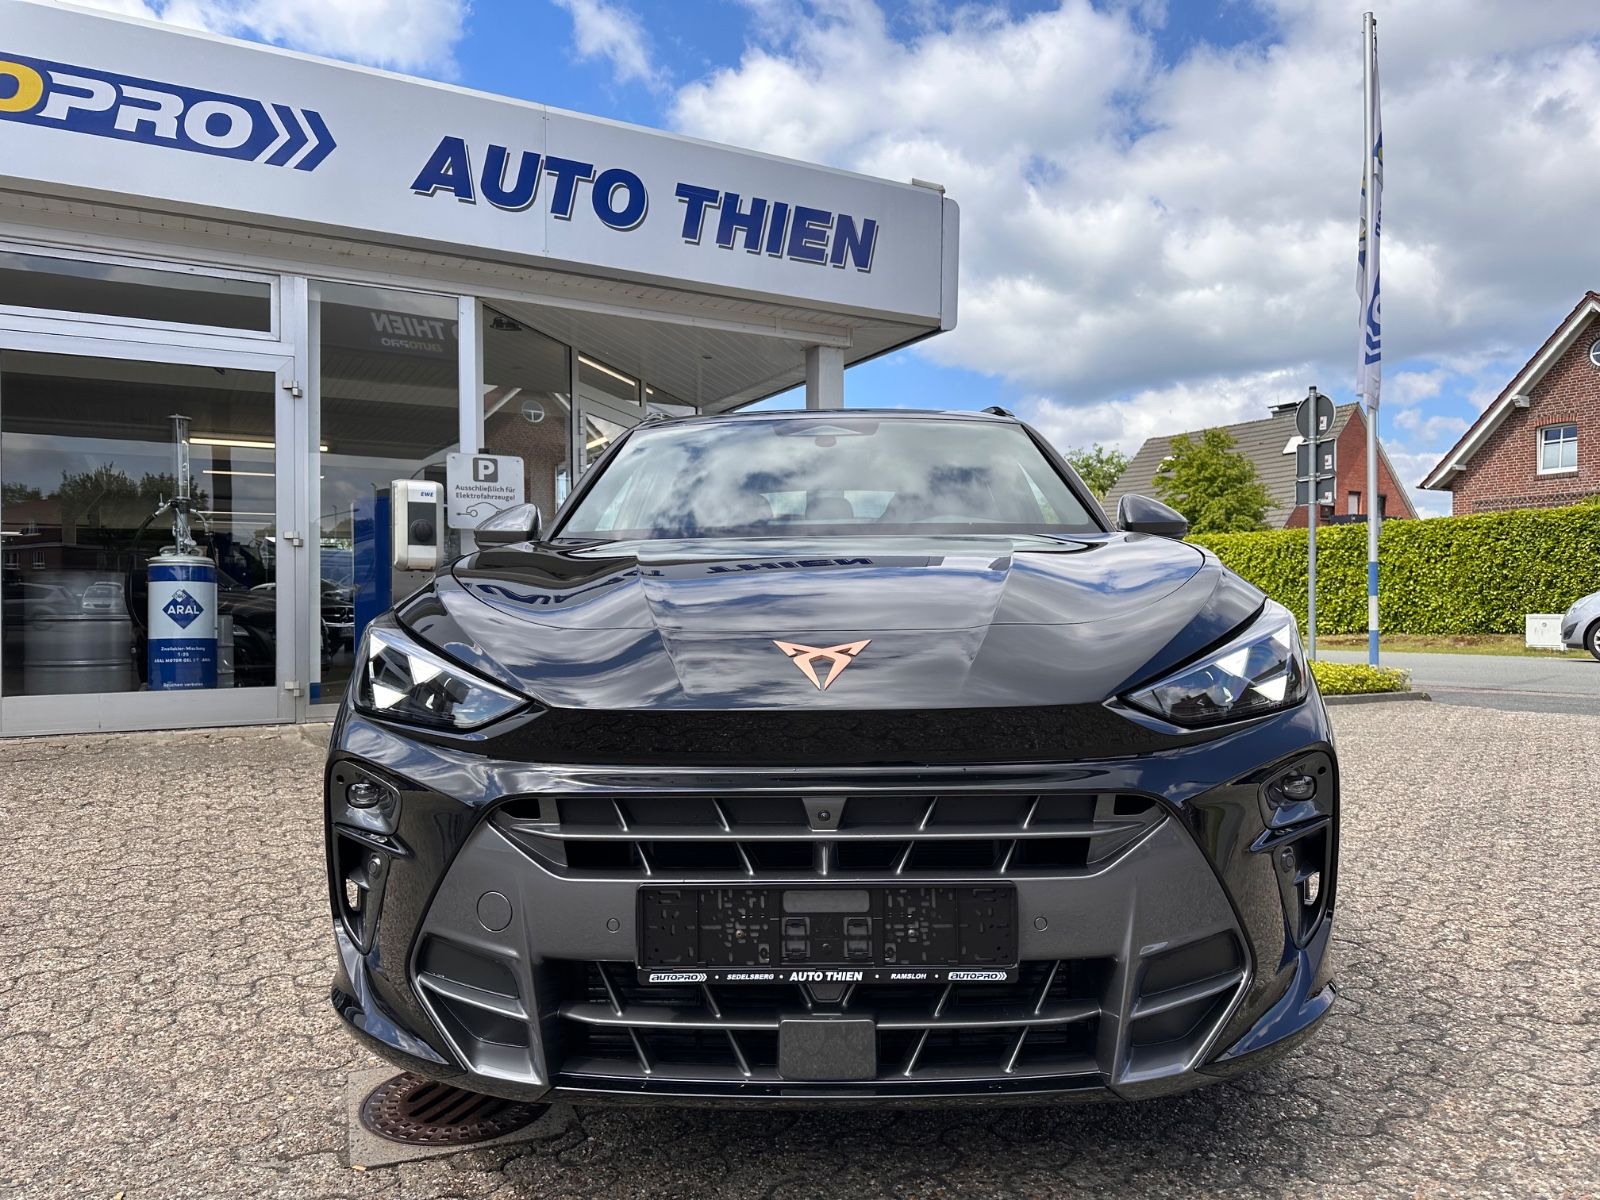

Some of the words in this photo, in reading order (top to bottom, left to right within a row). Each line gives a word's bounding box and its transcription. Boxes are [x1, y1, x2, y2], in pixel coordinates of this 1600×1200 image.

[410, 135, 648, 232] AUTO
[675, 182, 879, 273] THIEN
[478, 460, 495, 480] P
[455, 484, 504, 493] Ausschließlich
[167, 605, 200, 615] ARAL
[789, 972, 823, 981] AUTO
[826, 972, 863, 981] THIEN
